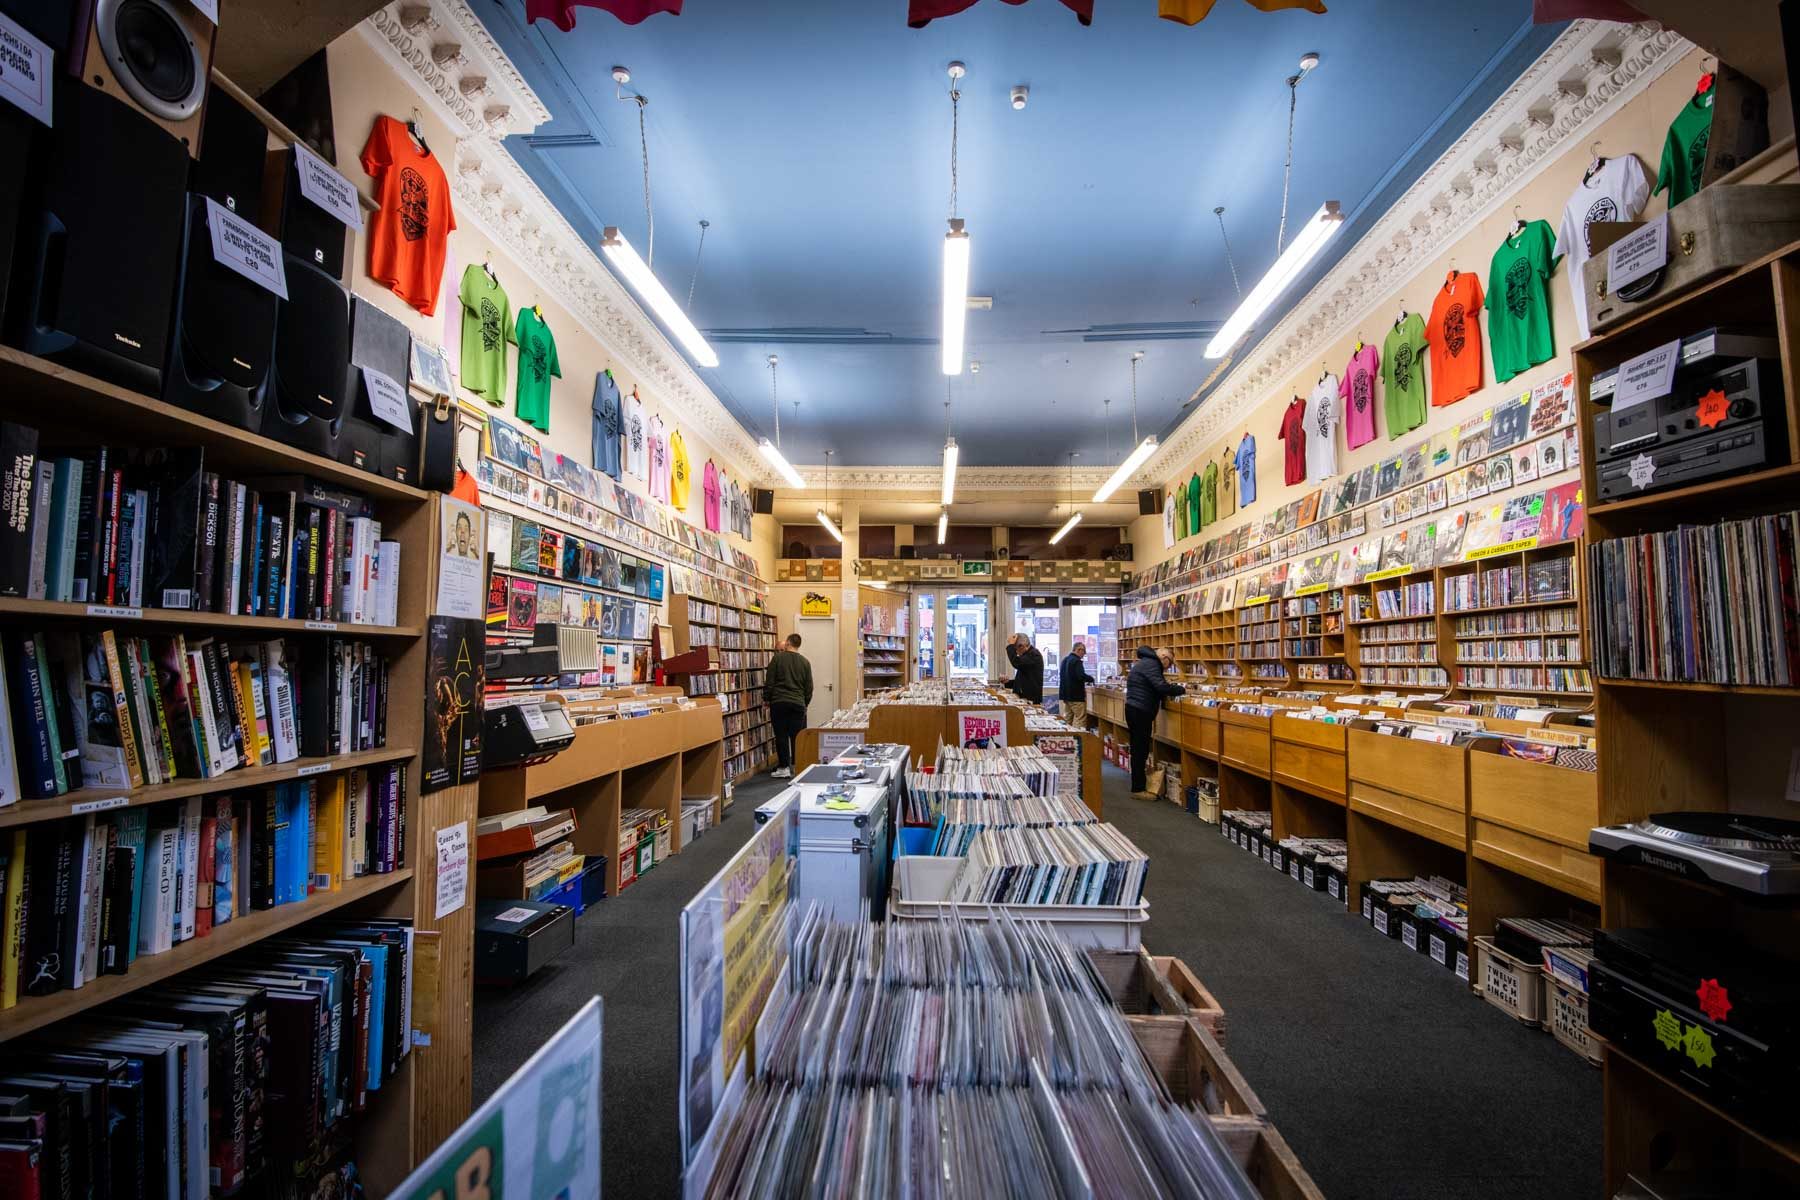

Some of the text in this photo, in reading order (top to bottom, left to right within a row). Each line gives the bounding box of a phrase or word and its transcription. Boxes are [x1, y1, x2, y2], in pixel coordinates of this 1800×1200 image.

[2, 470, 14, 512] 1970-2000
[8, 456, 23, 528] After The Break-Up
[17, 454, 34, 534] The Beatles
[206, 502, 216, 546] DICKSON
[308, 527, 319, 575] DAVE FANNING
[1491, 544, 1514, 554] CASSETTE
[1516, 541, 1532, 550] TAPES
[27, 668, 44, 724] JOHN PEEL
[212, 671, 225, 714] RICHARDS
[277, 684, 292, 719] SINATRA
[119, 706, 133, 741] Happy
[126, 741, 138, 768] Days
[964, 727, 1001, 741] FAIR
[160, 834, 173, 894] BLUES on CD
[1640, 850, 1688, 875] Numark
[59, 871, 71, 915] YOUNG
[187, 890, 195, 909] ROSS
[1487, 964, 1517, 988] TWELVE
[1487, 974, 1517, 998] INCH
[1487, 984, 1517, 1008] SINGLES
[1555, 998, 1586, 1024] TWELVE
[330, 1019, 342, 1052] SHOW
[1555, 1018, 1587, 1046] SINGLES
